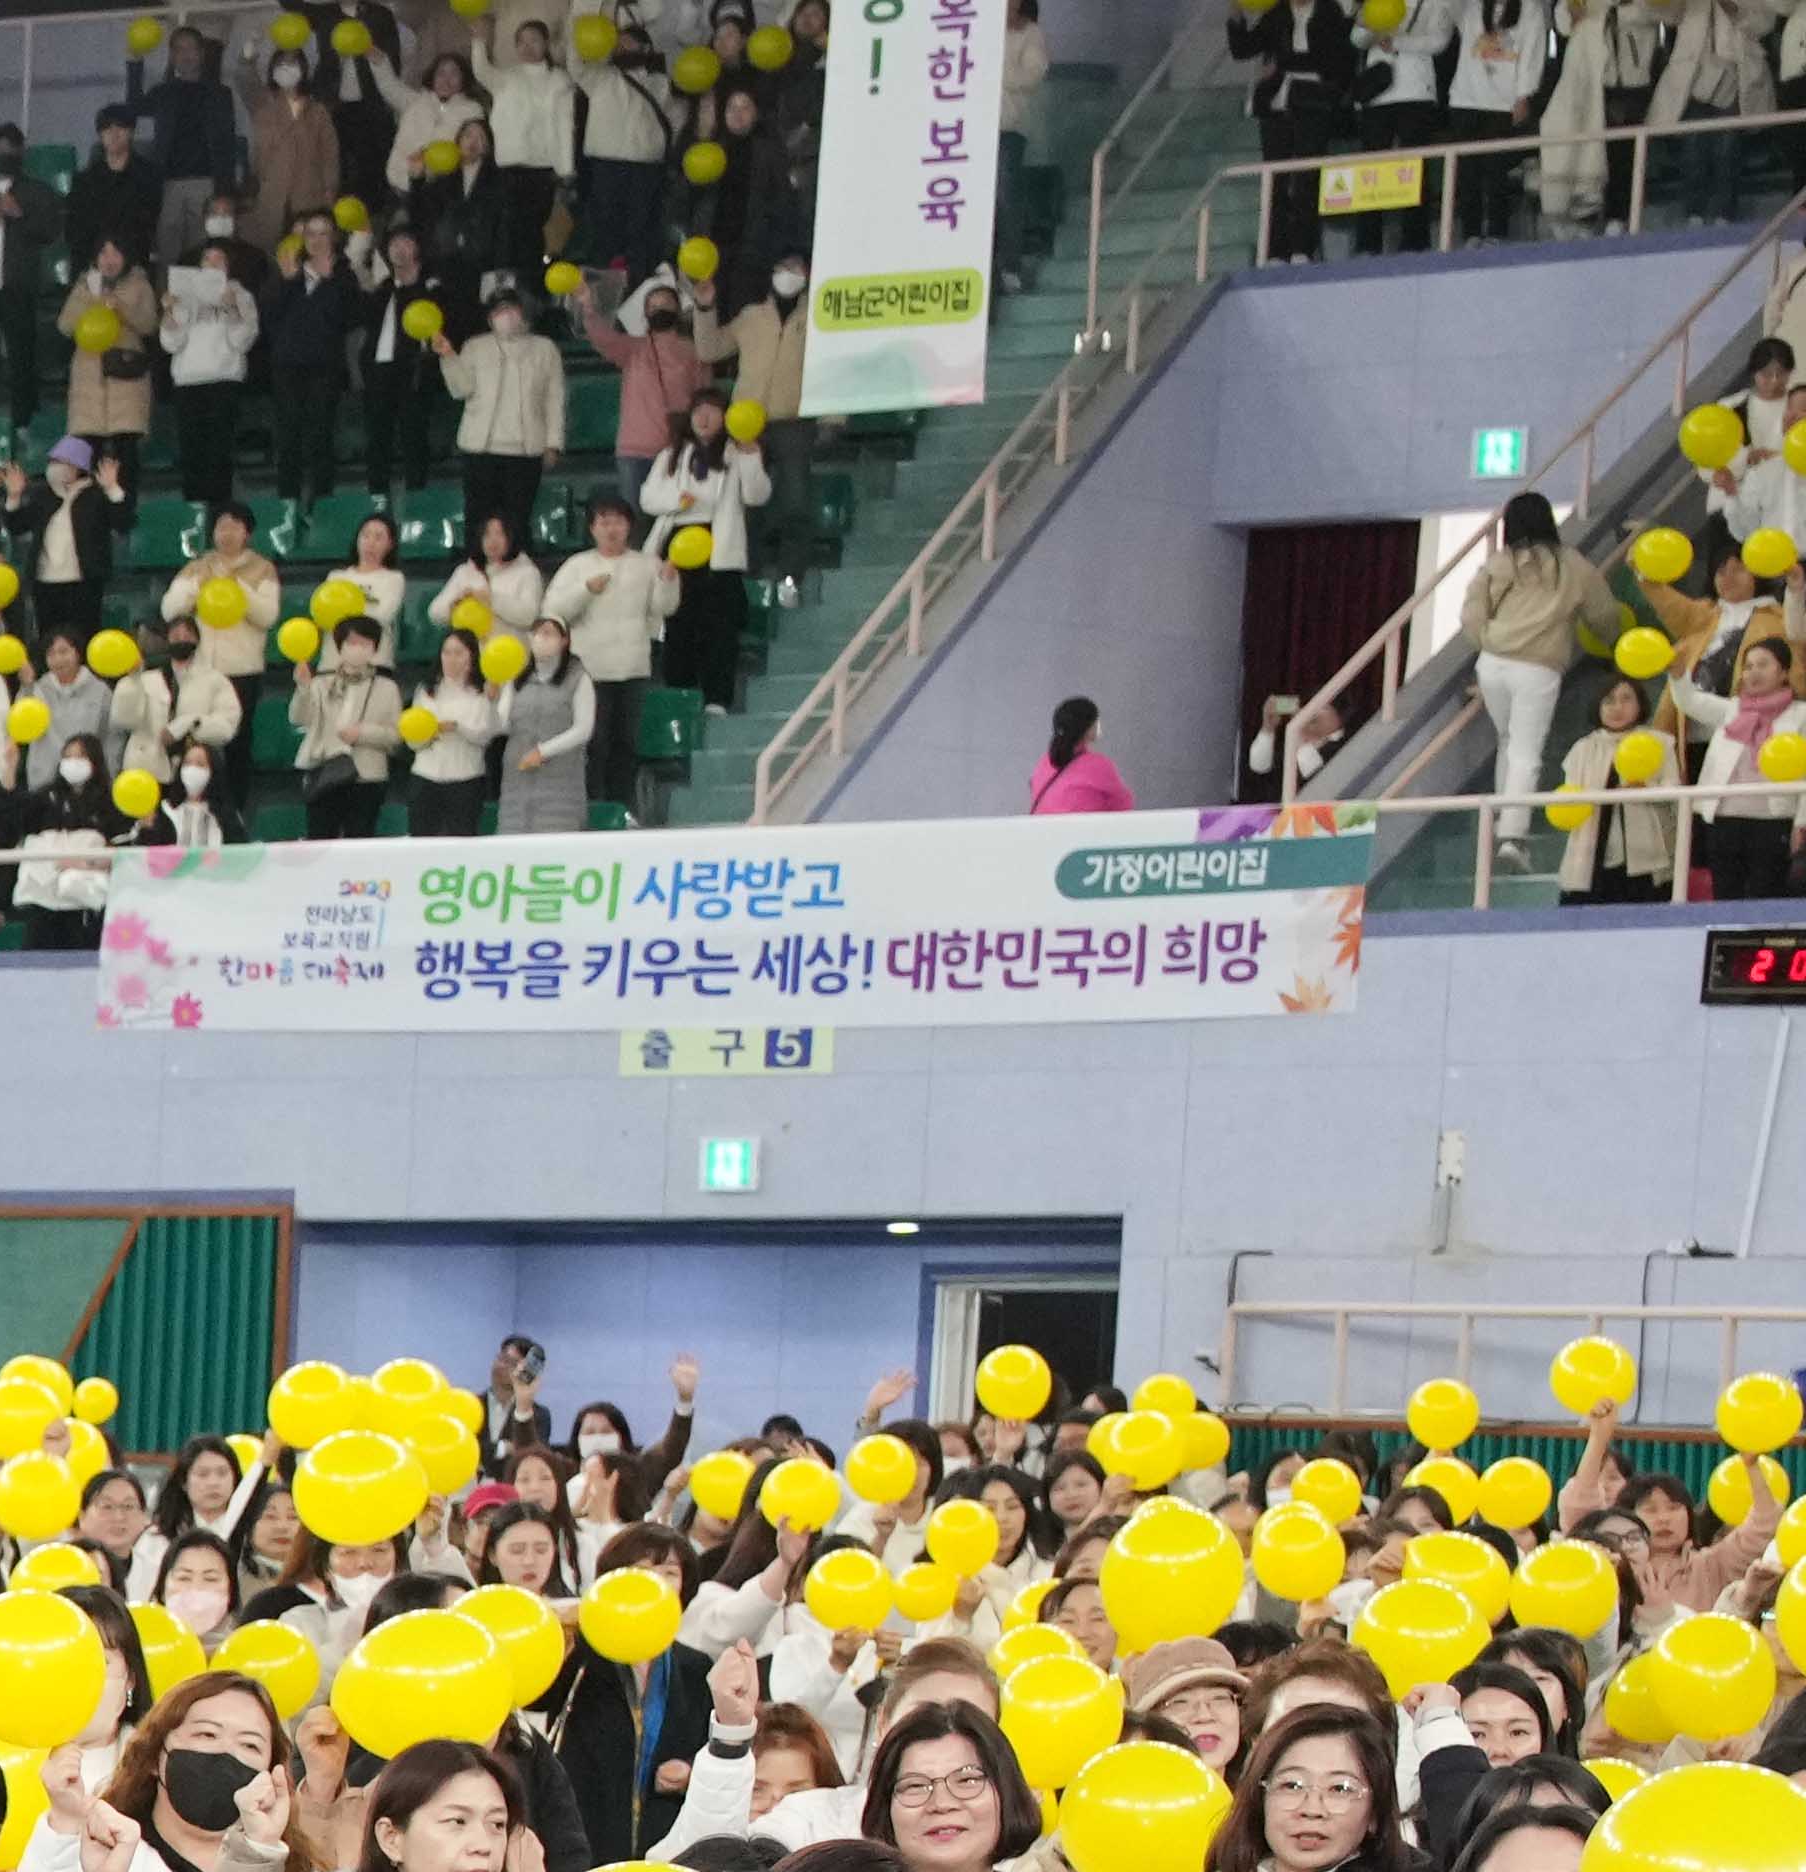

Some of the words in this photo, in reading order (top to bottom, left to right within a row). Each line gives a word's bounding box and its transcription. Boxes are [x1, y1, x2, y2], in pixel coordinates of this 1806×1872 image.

[918, 119, 969, 230] 보육
[823, 278, 971, 320] 해남군어린이집
[417, 862, 624, 927] 영아들이
[633, 857, 846, 921] 사랑받고
[1081, 847, 1270, 895] 가정어린이집
[414, 938, 569, 1001] 행복을
[580, 937, 740, 1000] 키우는
[751, 933, 876, 998] 세상!
[886, 922, 1149, 993] 대한민국의
[1162, 917, 1269, 986] 희망
[770, 1029, 806, 1068] 5
